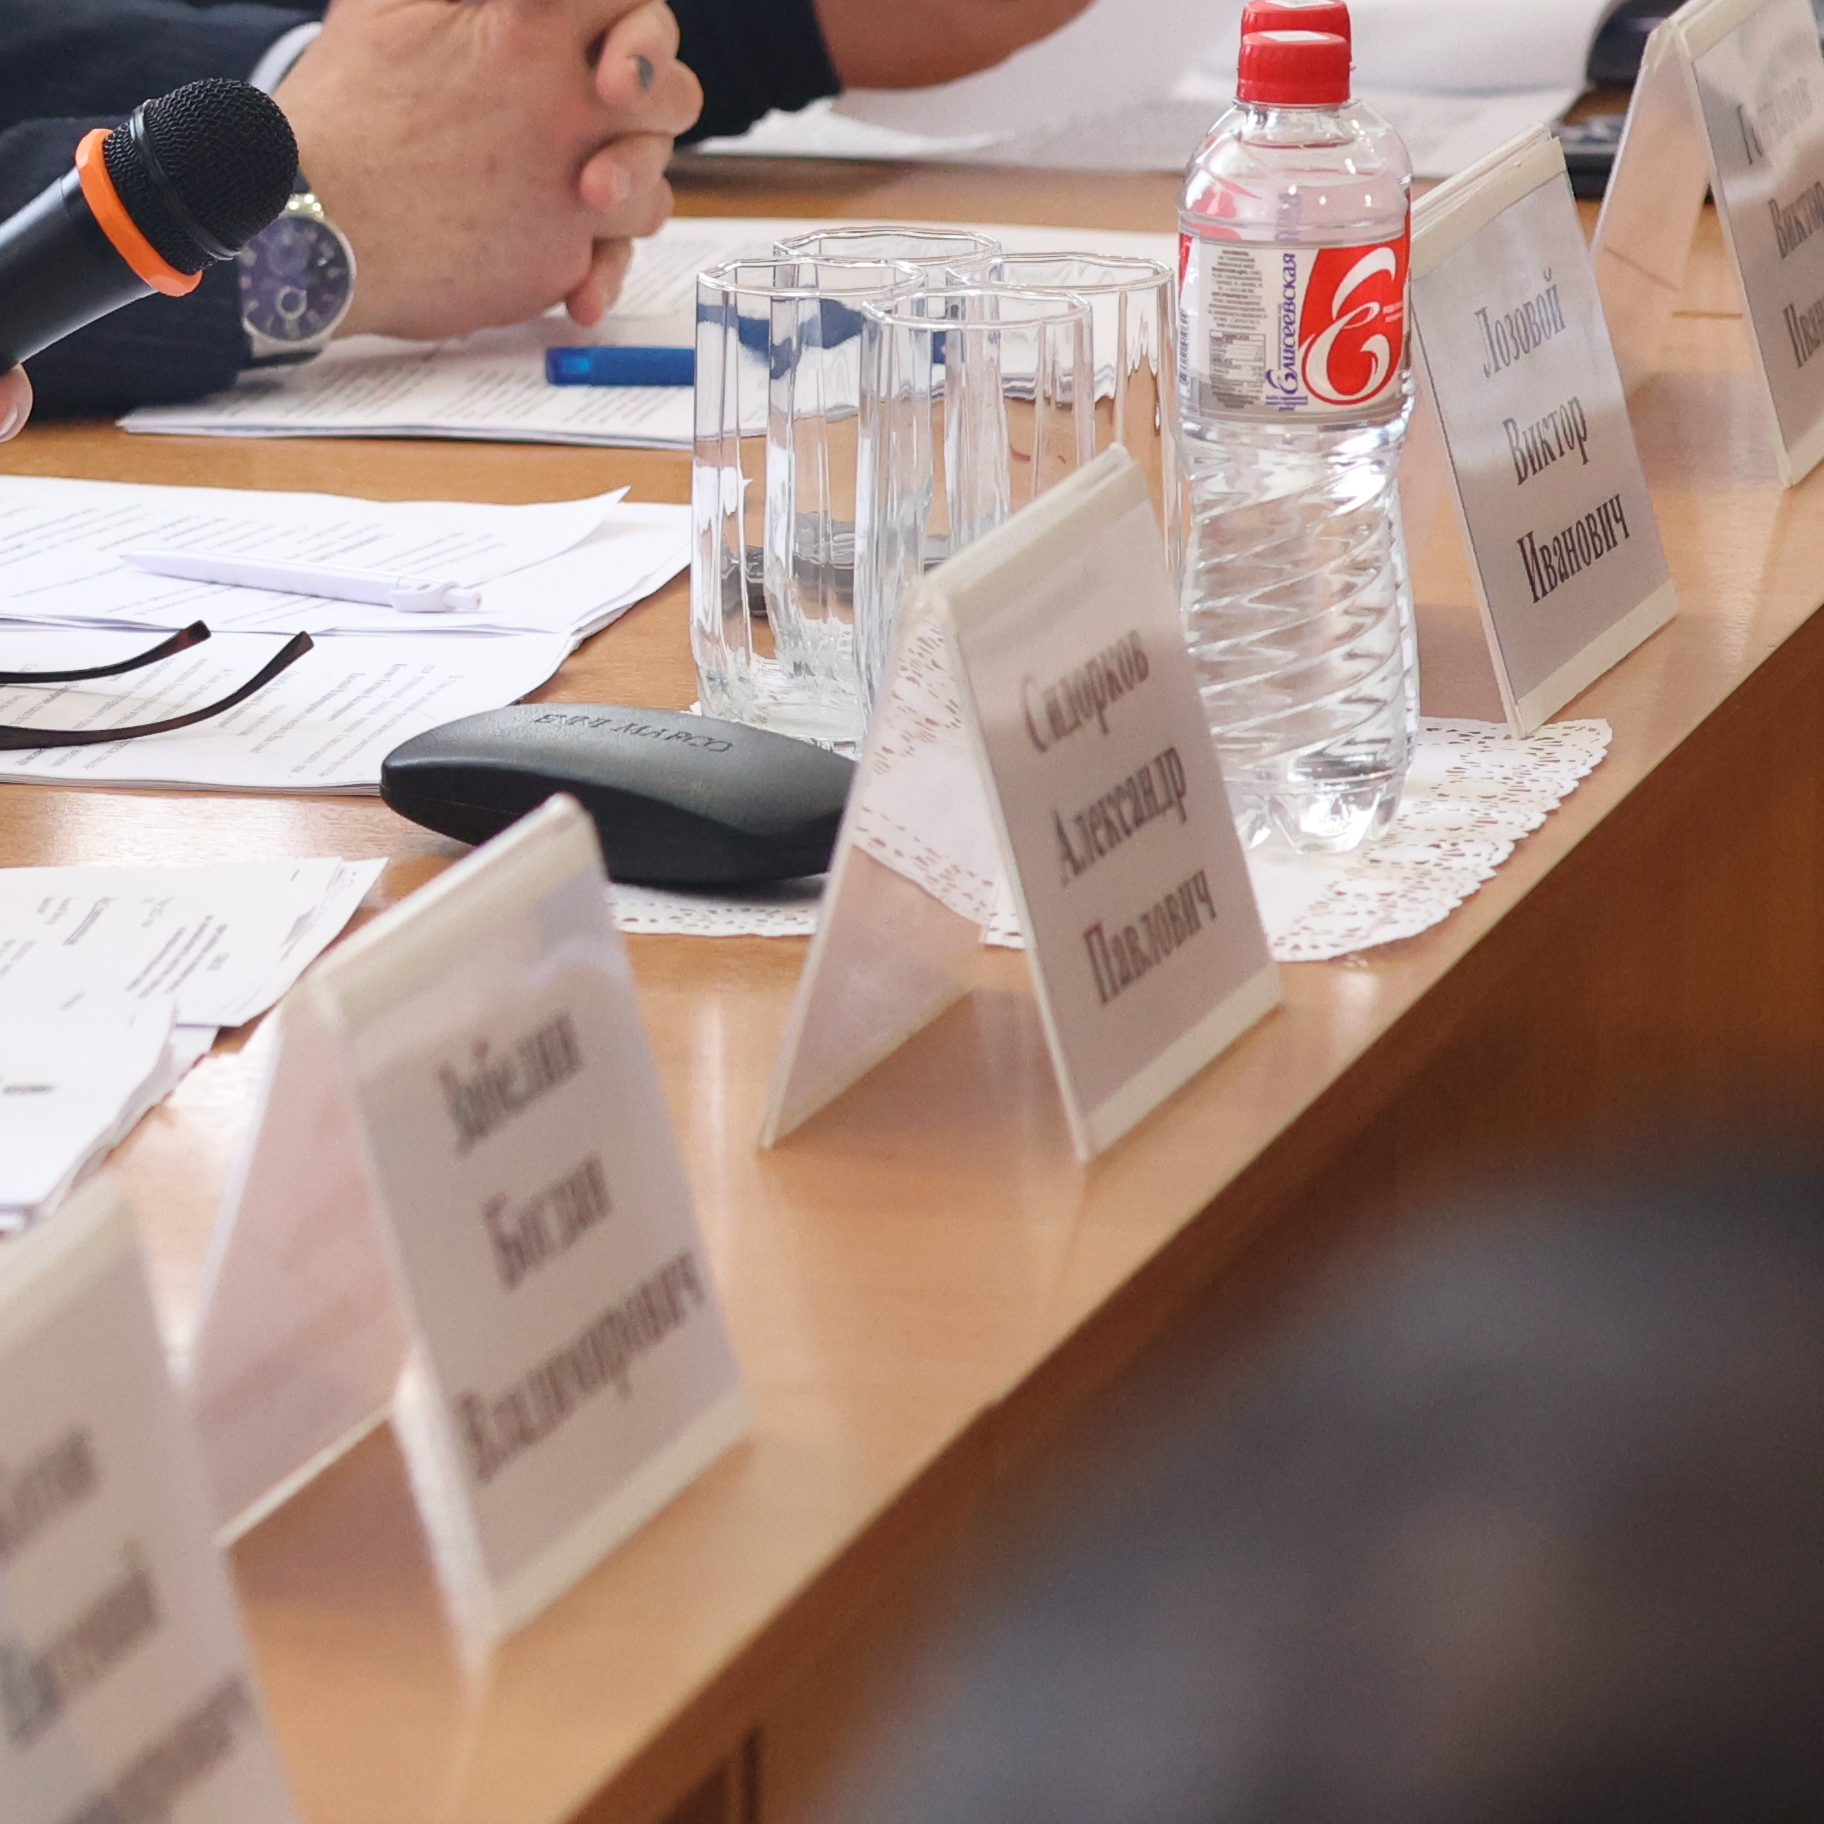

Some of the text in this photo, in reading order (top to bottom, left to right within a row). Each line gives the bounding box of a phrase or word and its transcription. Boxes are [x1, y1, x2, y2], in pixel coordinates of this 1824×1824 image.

[1474, 266, 1567, 379] Лозовой
[1502, 395, 1588, 486] Виктор
[1516, 493, 1630, 604] Иванович
[1052, 746, 1188, 888] Александр
[1082, 869, 1219, 1005] Павлович
